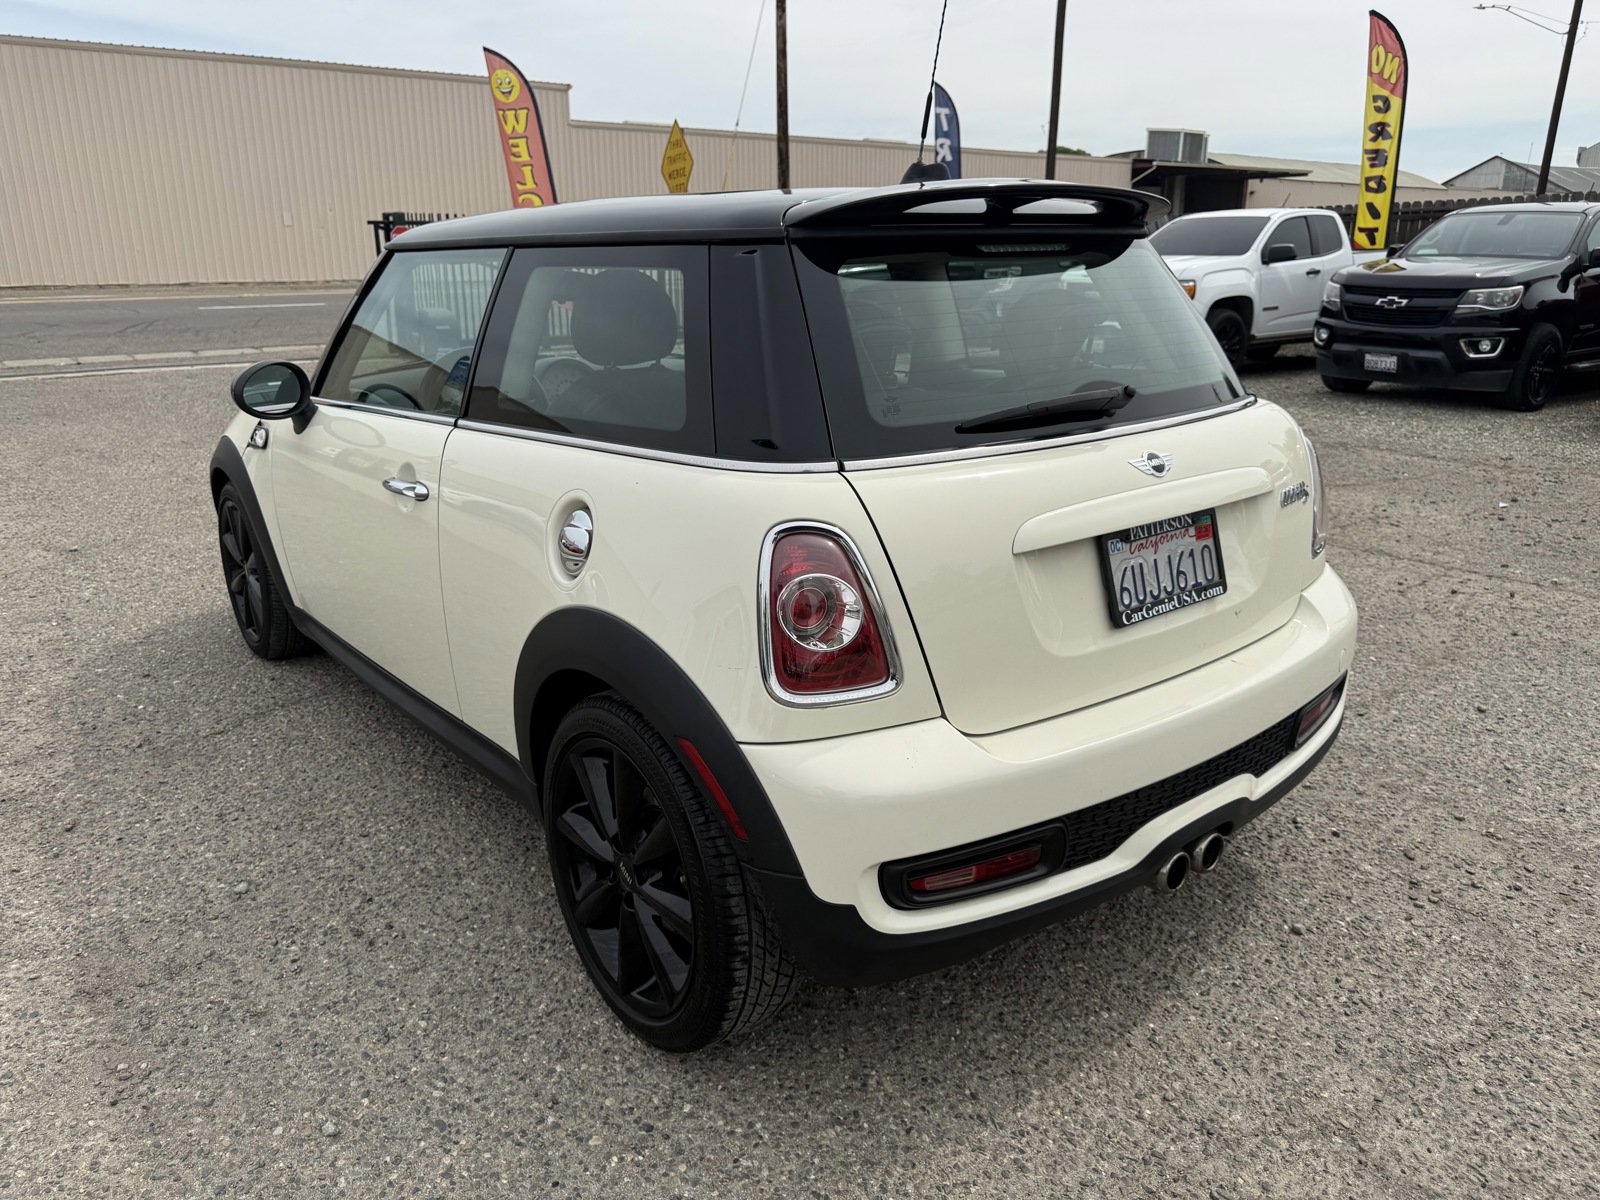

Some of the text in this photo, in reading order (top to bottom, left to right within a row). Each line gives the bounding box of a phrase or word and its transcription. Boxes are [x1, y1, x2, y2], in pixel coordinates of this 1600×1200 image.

[668, 167, 687, 180] MERGE
[1130, 514, 1193, 541] PATTERSON
[1129, 528, 1195, 555] California
[1120, 544, 1215, 609] 6UJJ610
[1122, 585, 1224, 625] CarGenieUSA.com
